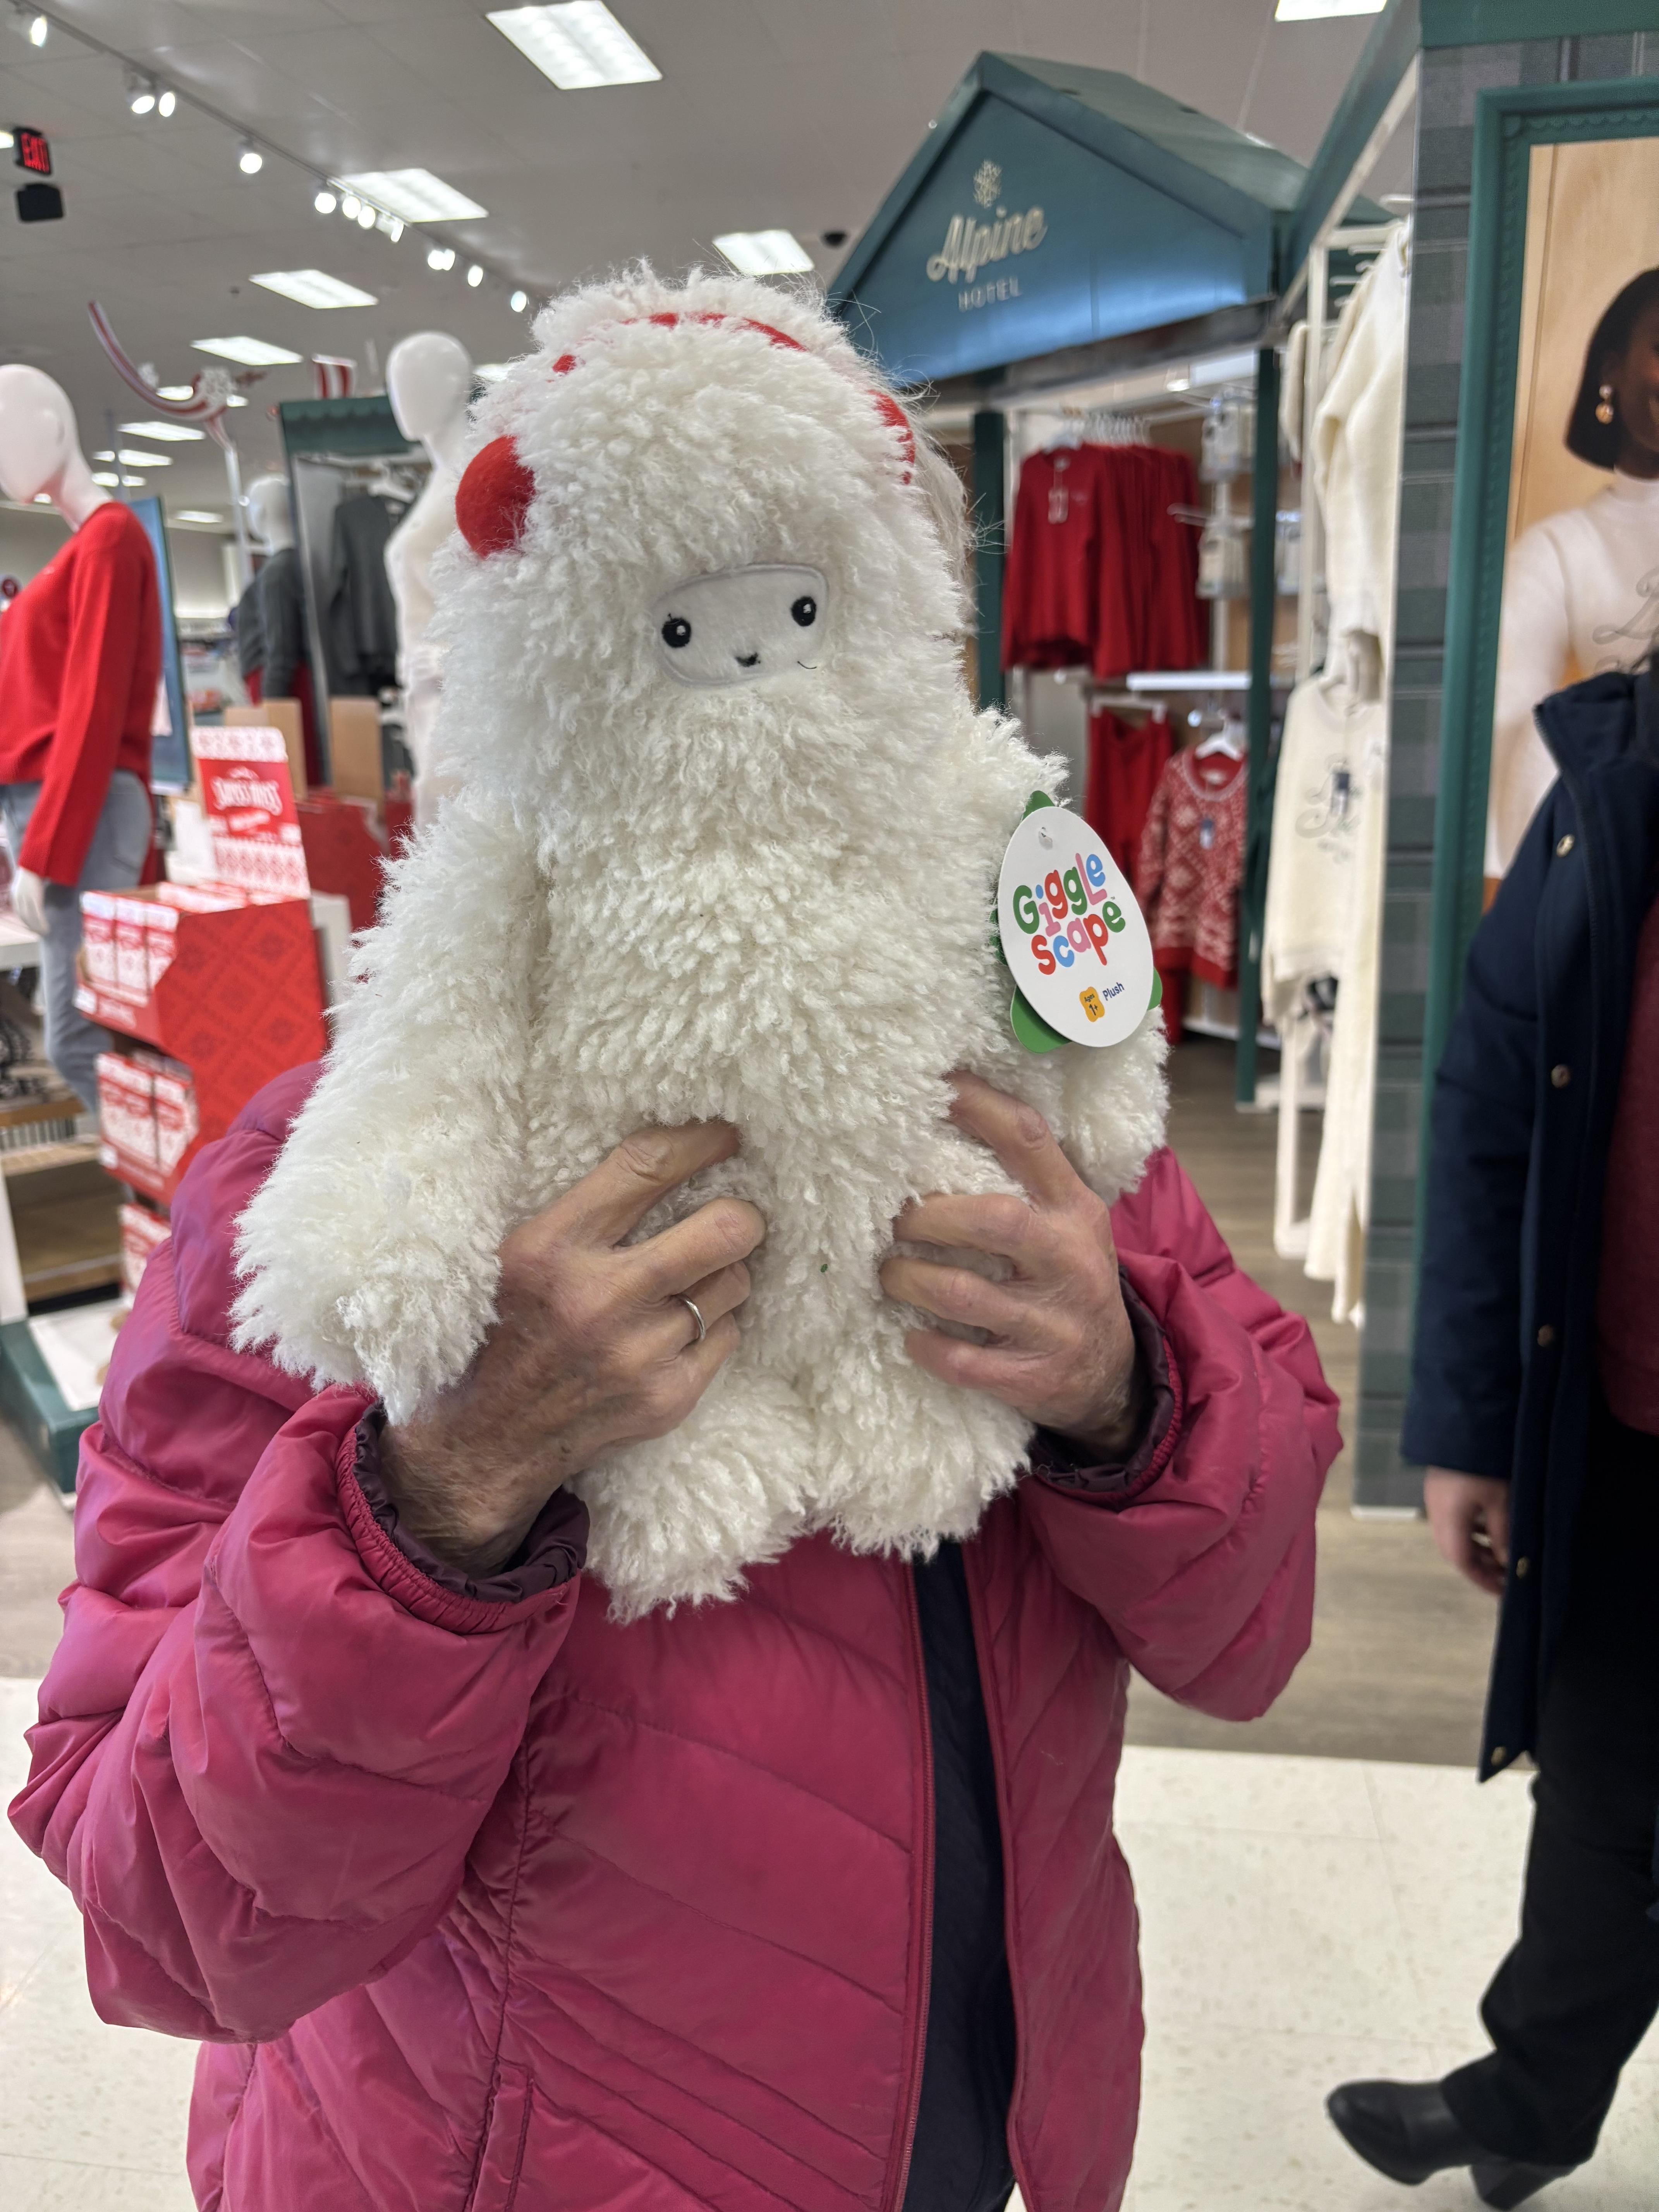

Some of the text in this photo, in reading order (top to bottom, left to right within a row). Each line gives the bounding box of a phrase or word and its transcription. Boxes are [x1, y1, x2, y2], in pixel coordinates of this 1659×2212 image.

[20, 132, 49, 173] EXIT
[927, 207, 1048, 285] Alpine
[958, 276, 1024, 312] HOTEL
[1084, 994, 1095, 1003] Ages
[1103, 982, 1125, 1001] Plush
[1089, 1004, 1098, 1016] 1+
